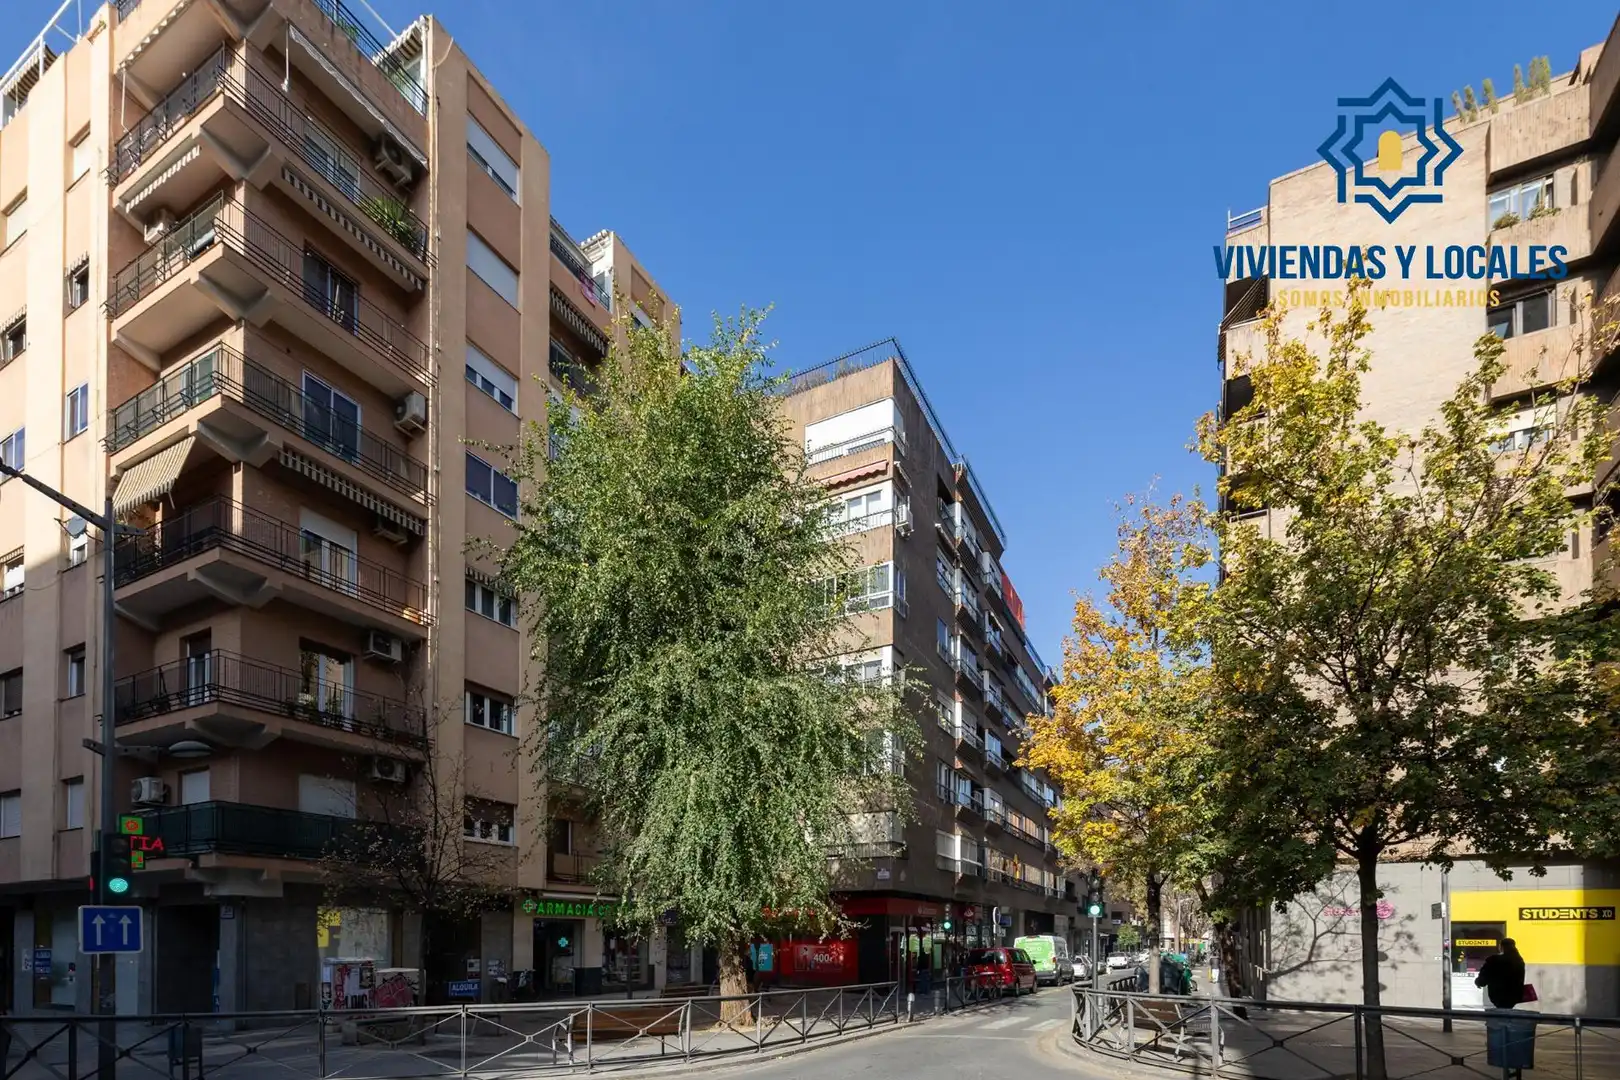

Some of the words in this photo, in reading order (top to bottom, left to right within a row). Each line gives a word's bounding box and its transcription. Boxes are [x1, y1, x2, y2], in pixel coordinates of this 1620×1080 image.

[529, 902, 594, 917] ARMACIA
[1522, 908, 1598, 919] STUDENTS
[451, 983, 479, 991] ALQUILA
